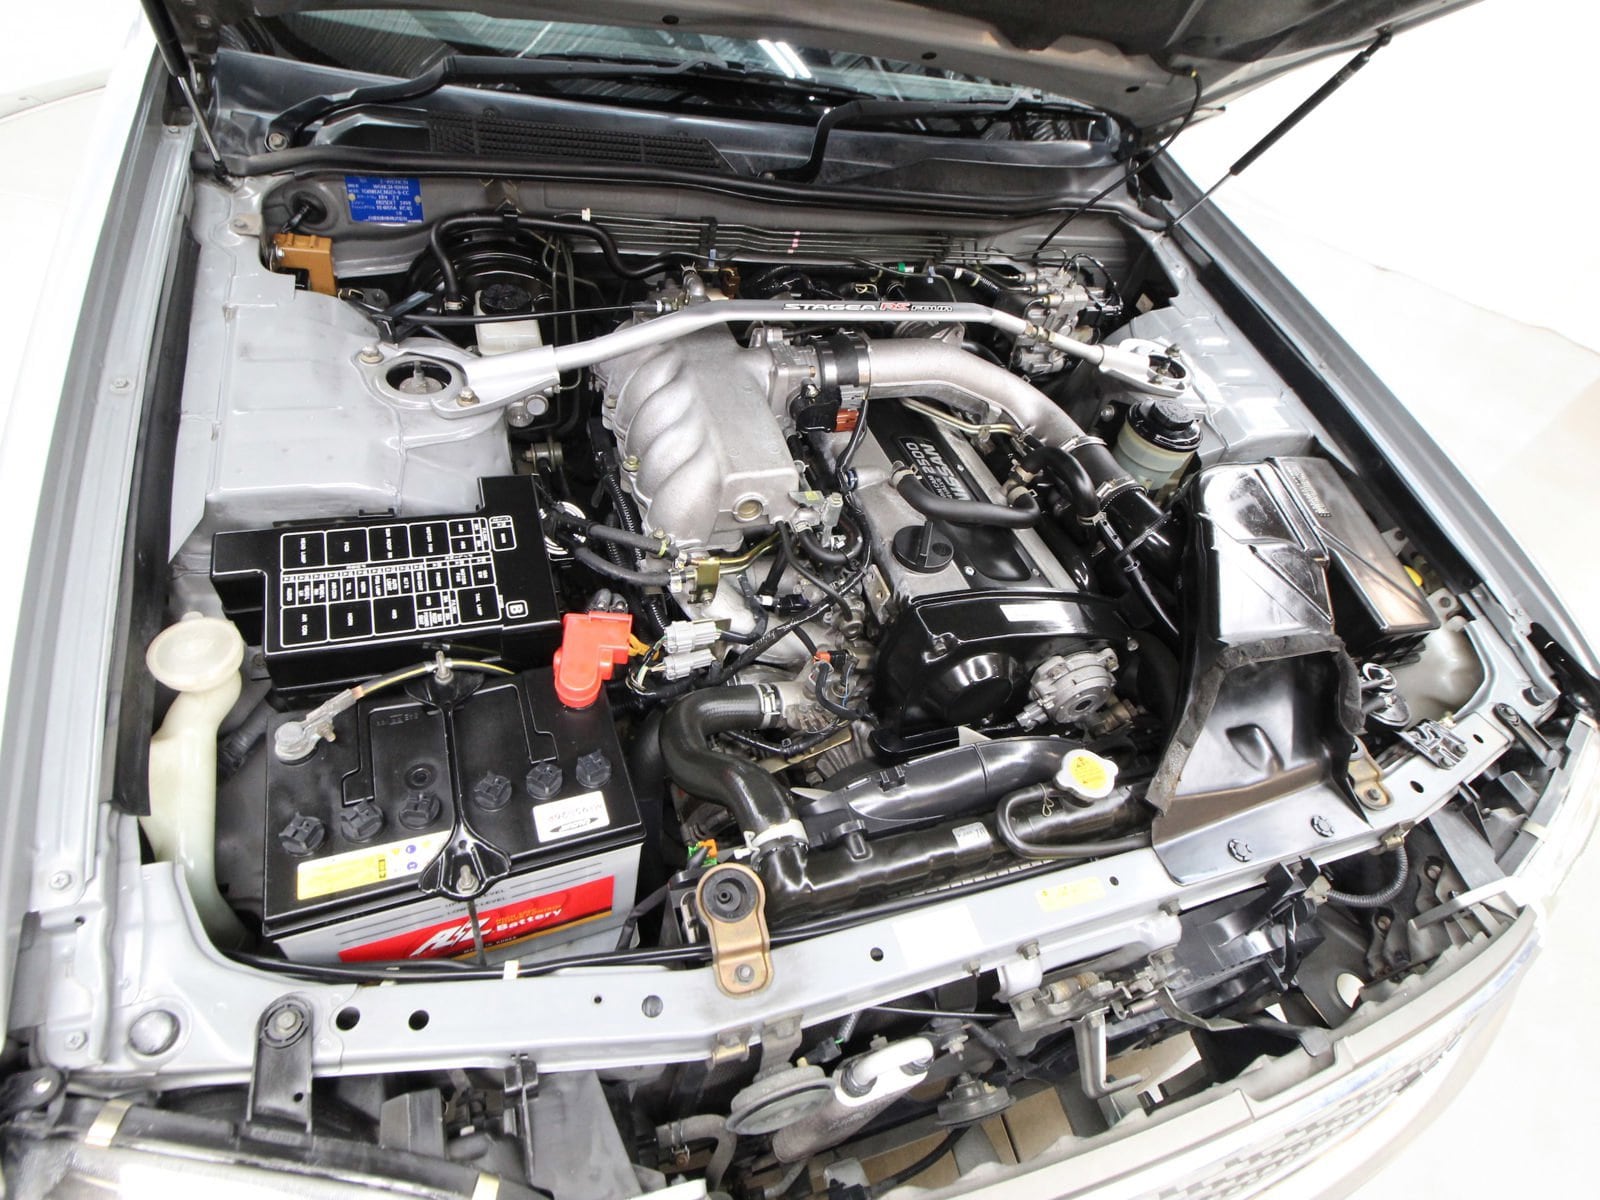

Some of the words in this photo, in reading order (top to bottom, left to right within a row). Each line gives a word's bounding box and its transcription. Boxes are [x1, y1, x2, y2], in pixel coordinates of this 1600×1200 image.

[783, 303, 876, 311] STAGEA
[905, 442, 937, 474] 2500
[919, 443, 971, 500] NISSAN
[510, 604, 524, 614] B
[497, 909, 562, 932] Battery
